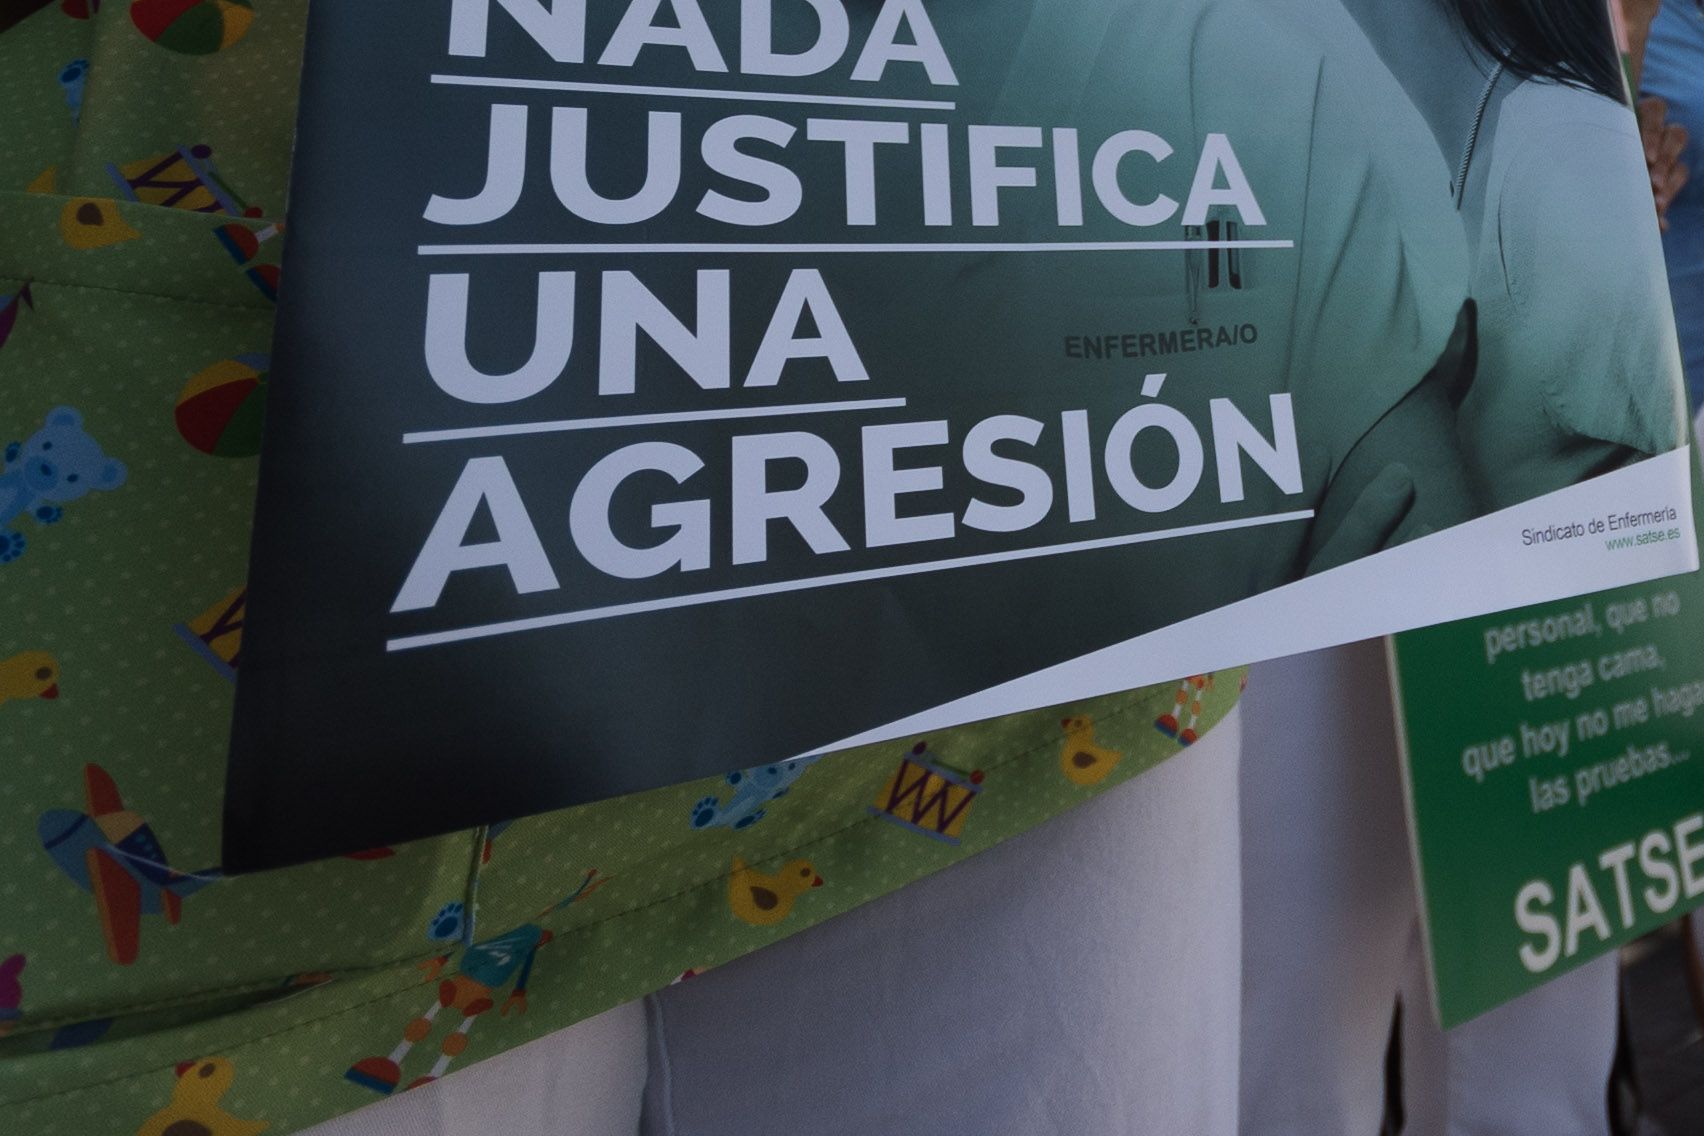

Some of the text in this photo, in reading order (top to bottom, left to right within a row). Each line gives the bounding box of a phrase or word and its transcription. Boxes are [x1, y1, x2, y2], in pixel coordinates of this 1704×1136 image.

[422, 103, 1267, 227] JUSTIFICA
[424, 268, 870, 405] UNA
[1064, 323, 1258, 360] ENFERMERA/O
[389, 373, 1303, 614] AGRESIÓN
[1521, 521, 1585, 546] Sindicato
[1588, 518, 1605, 534] de
[1605, 526, 1681, 552] www.satse.es
[1606, 599, 1650, 631] que
[1652, 590, 1681, 618] no
[1521, 658, 1595, 701] tenga
[1462, 738, 1515, 783] que
[1520, 721, 1571, 759] hoy
[1577, 710, 1609, 742] no
[1614, 698, 1648, 731] me
[1528, 774, 1570, 814] las
